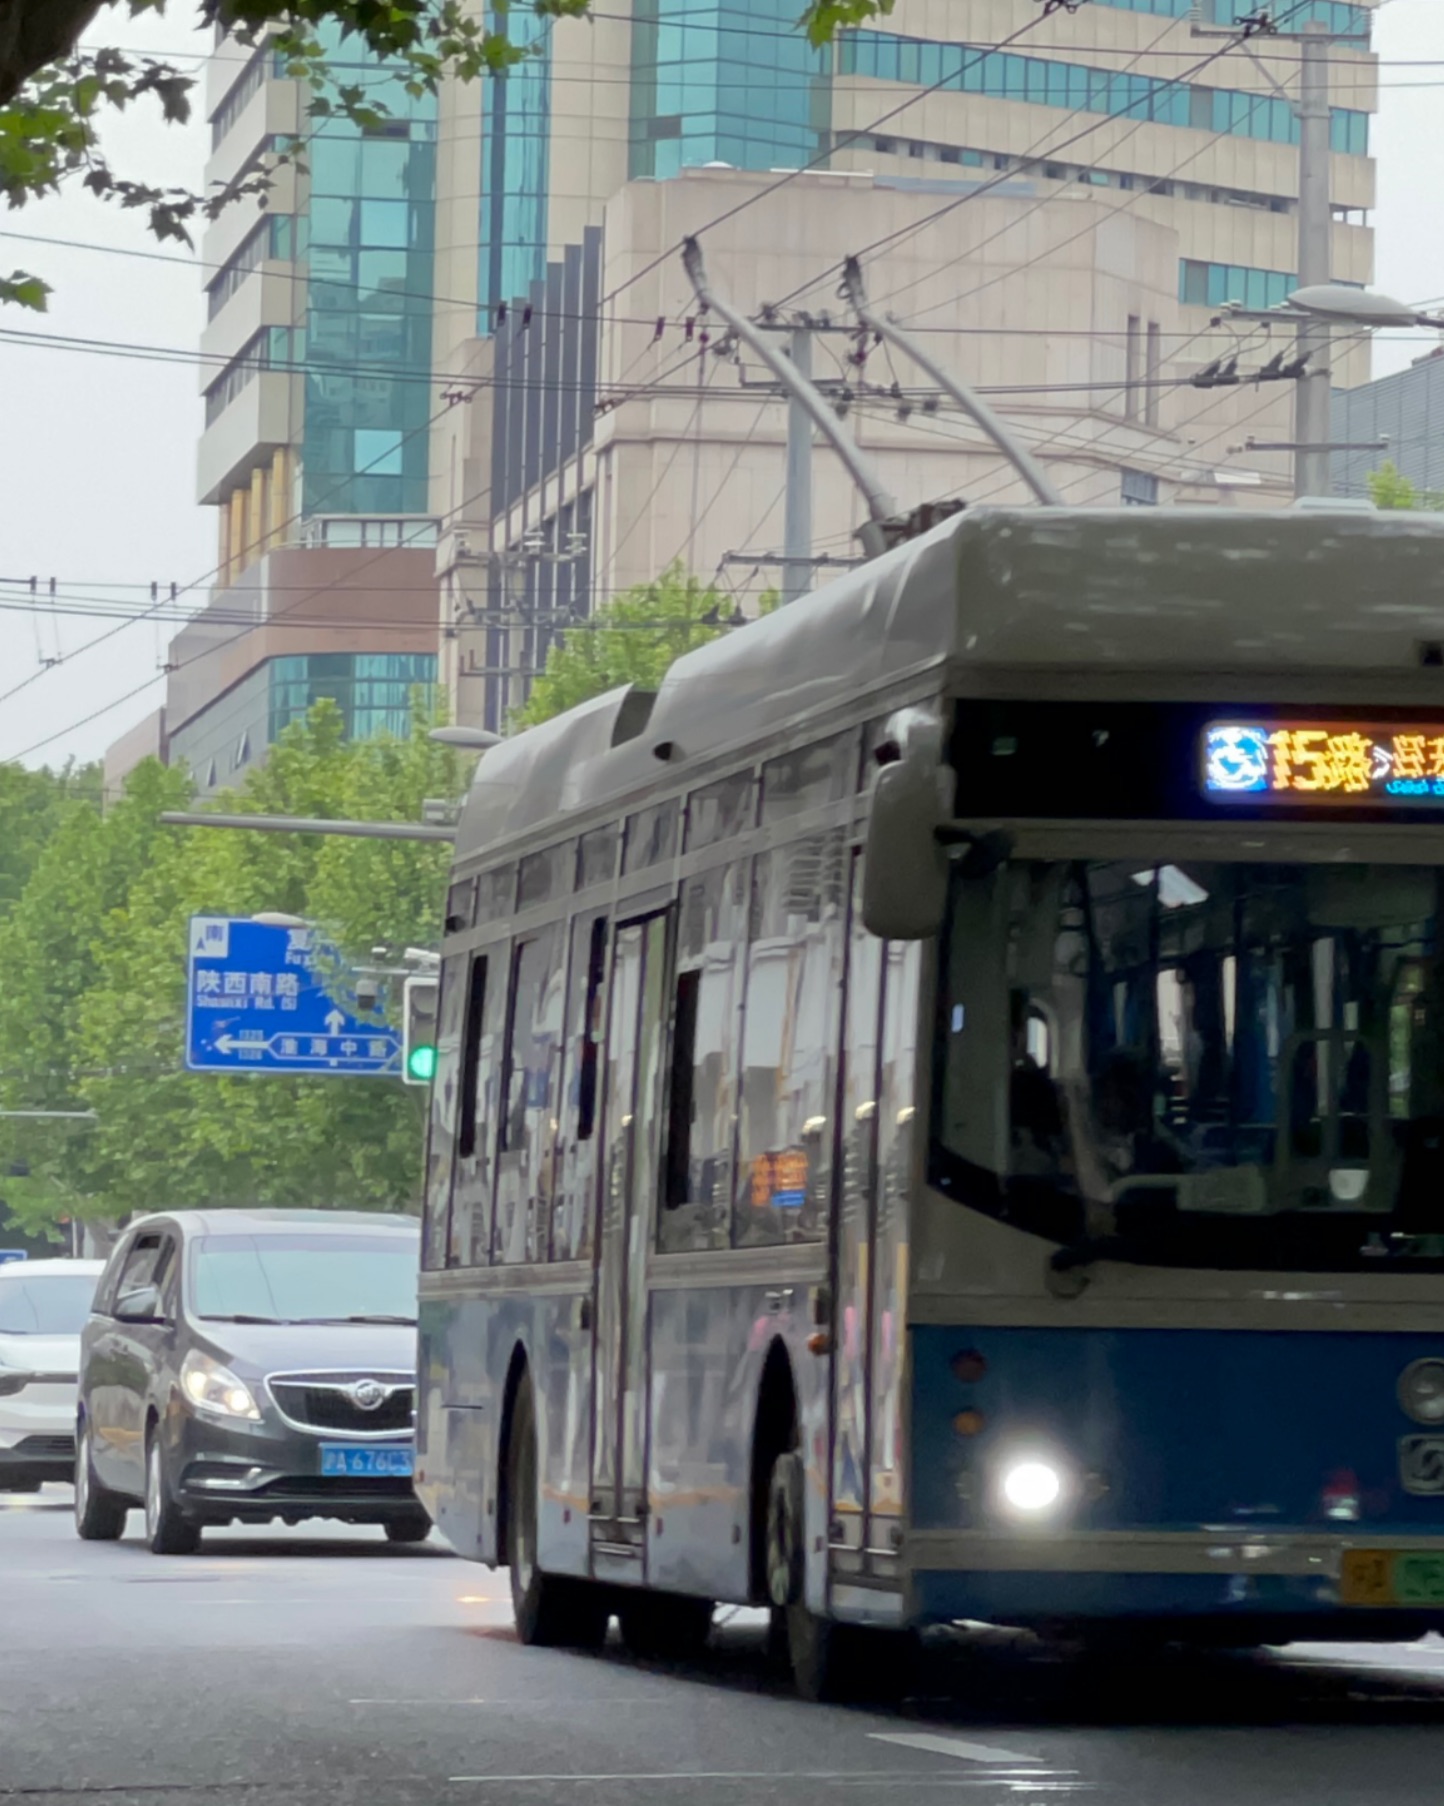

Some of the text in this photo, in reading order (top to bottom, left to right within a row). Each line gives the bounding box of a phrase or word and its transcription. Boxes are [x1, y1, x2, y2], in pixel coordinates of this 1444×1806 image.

[206, 924, 225, 942] 南
[197, 969, 299, 997] 陕西南路
[281, 1037, 386, 1058] 淮海中路
